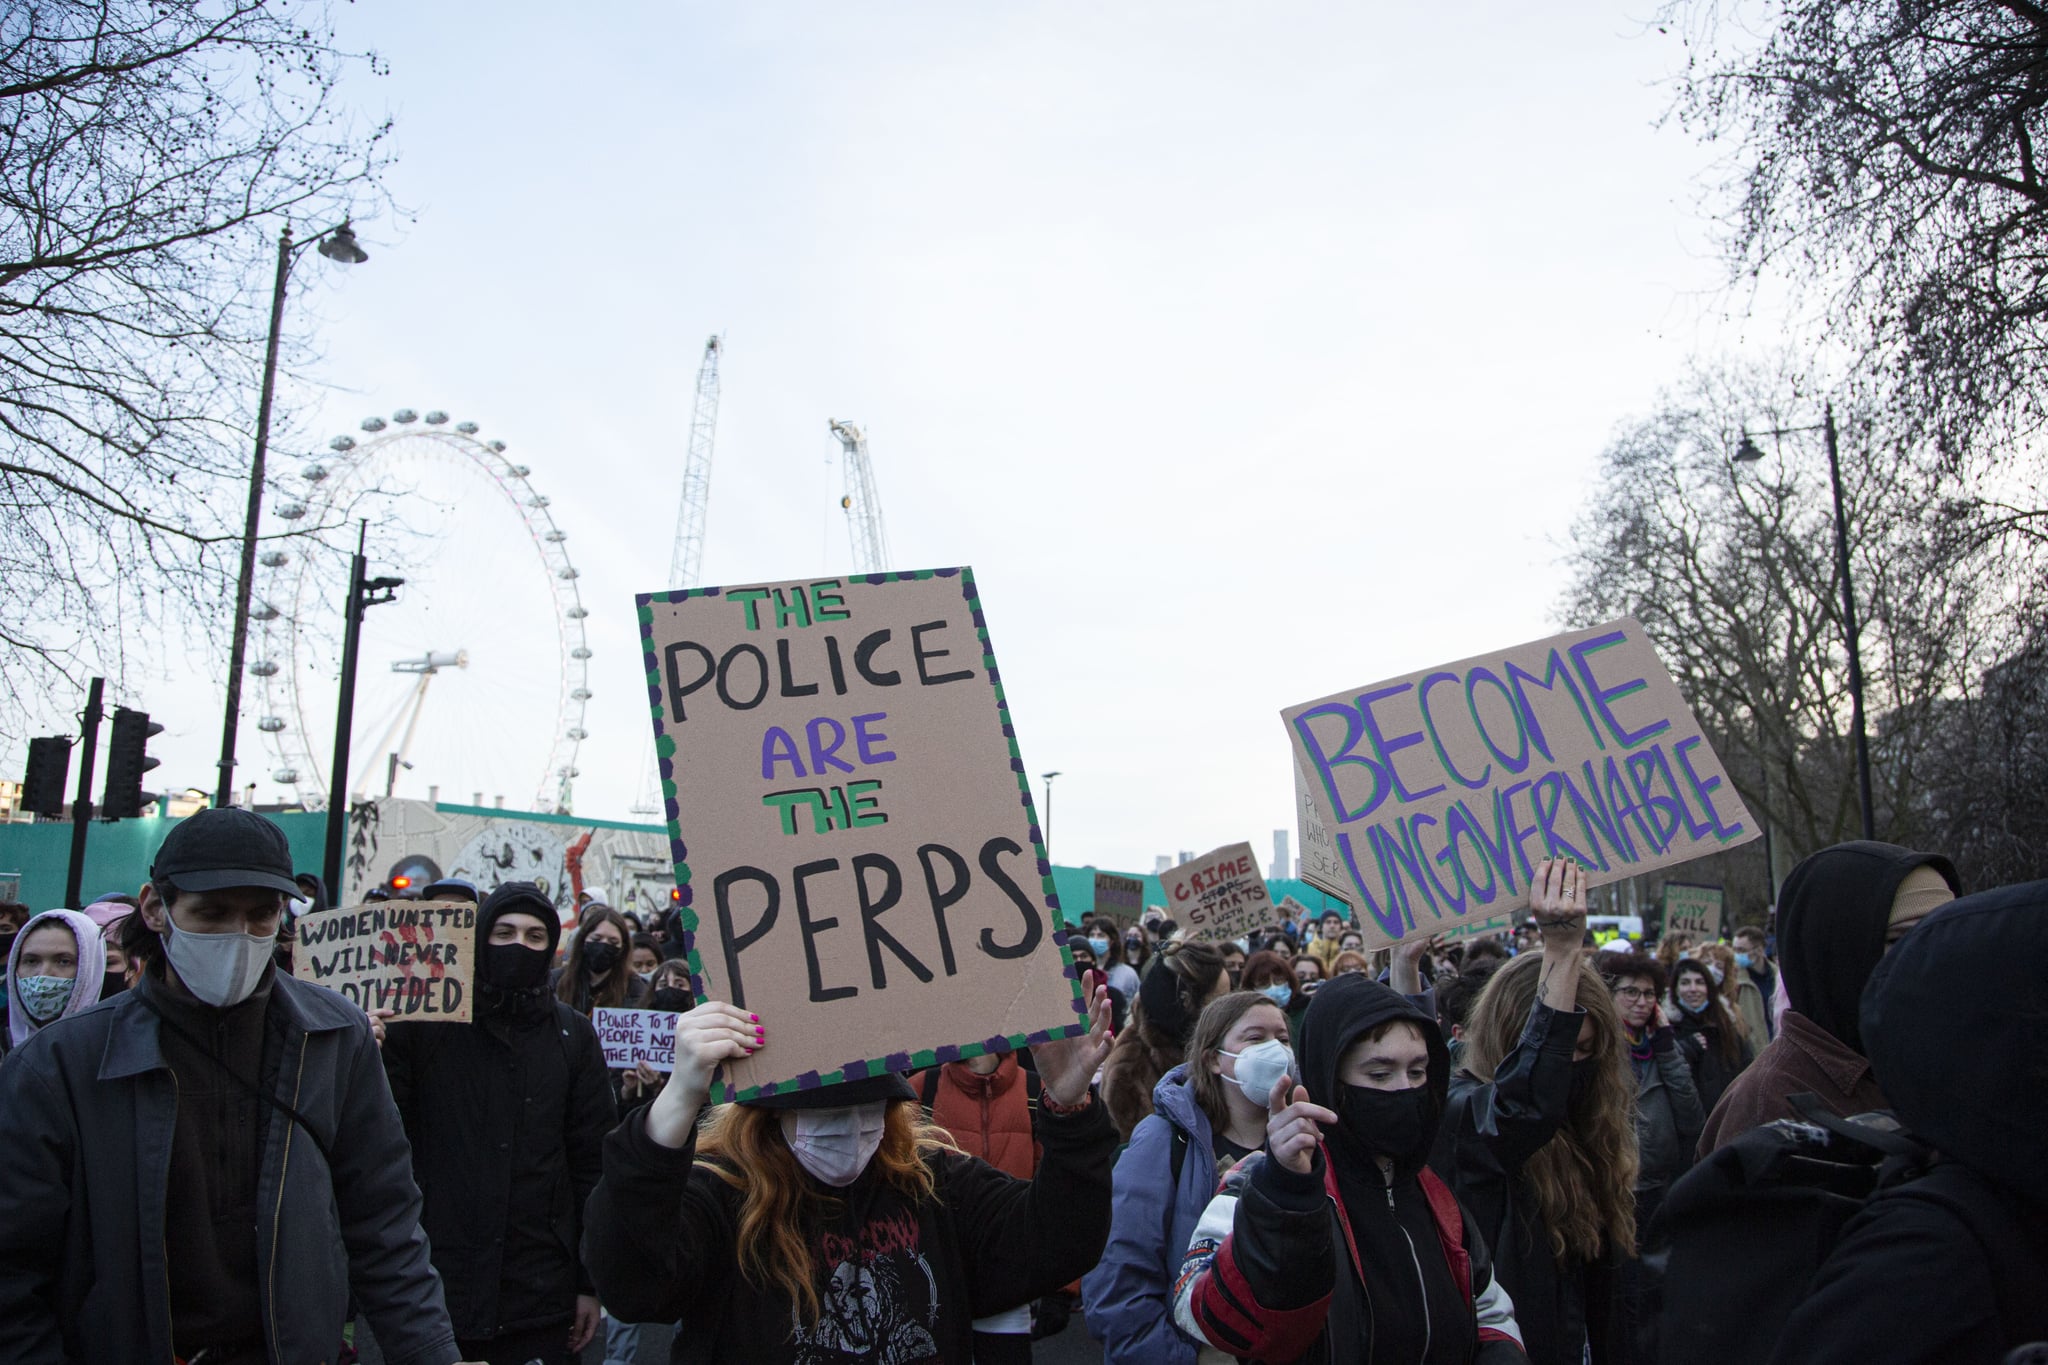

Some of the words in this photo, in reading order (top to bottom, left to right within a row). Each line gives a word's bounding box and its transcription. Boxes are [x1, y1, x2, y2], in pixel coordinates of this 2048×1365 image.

[726, 580, 851, 630] THE
[664, 620, 975, 723] POLICE
[761, 711, 897, 780] ARE
[1293, 630, 1671, 824] BECOME
[763, 779, 888, 835] THE
[1336, 735, 1744, 940] UNGOVERNABLE
[1174, 855, 1252, 902] CRIME
[713, 836, 1043, 1007] PERPS
[1189, 885, 1265, 925] STARTS
[1212, 907, 1244, 926] WITH
[1670, 915, 1710, 932] KILL
[301, 909, 385, 946] WOMEN
[388, 908, 475, 929] UNITED
[312, 944, 377, 979] WILL
[384, 942, 458, 967] NEVER
[598, 1010, 642, 1029] POWER
[647, 1013, 661, 1029] TO
[664, 1013, 678, 1031] TH
[598, 1028, 644, 1044] PEOPLE
[651, 1032, 675, 1050] NOT
[603, 1047, 628, 1062] THE
[630, 1047, 675, 1064] POLICE
